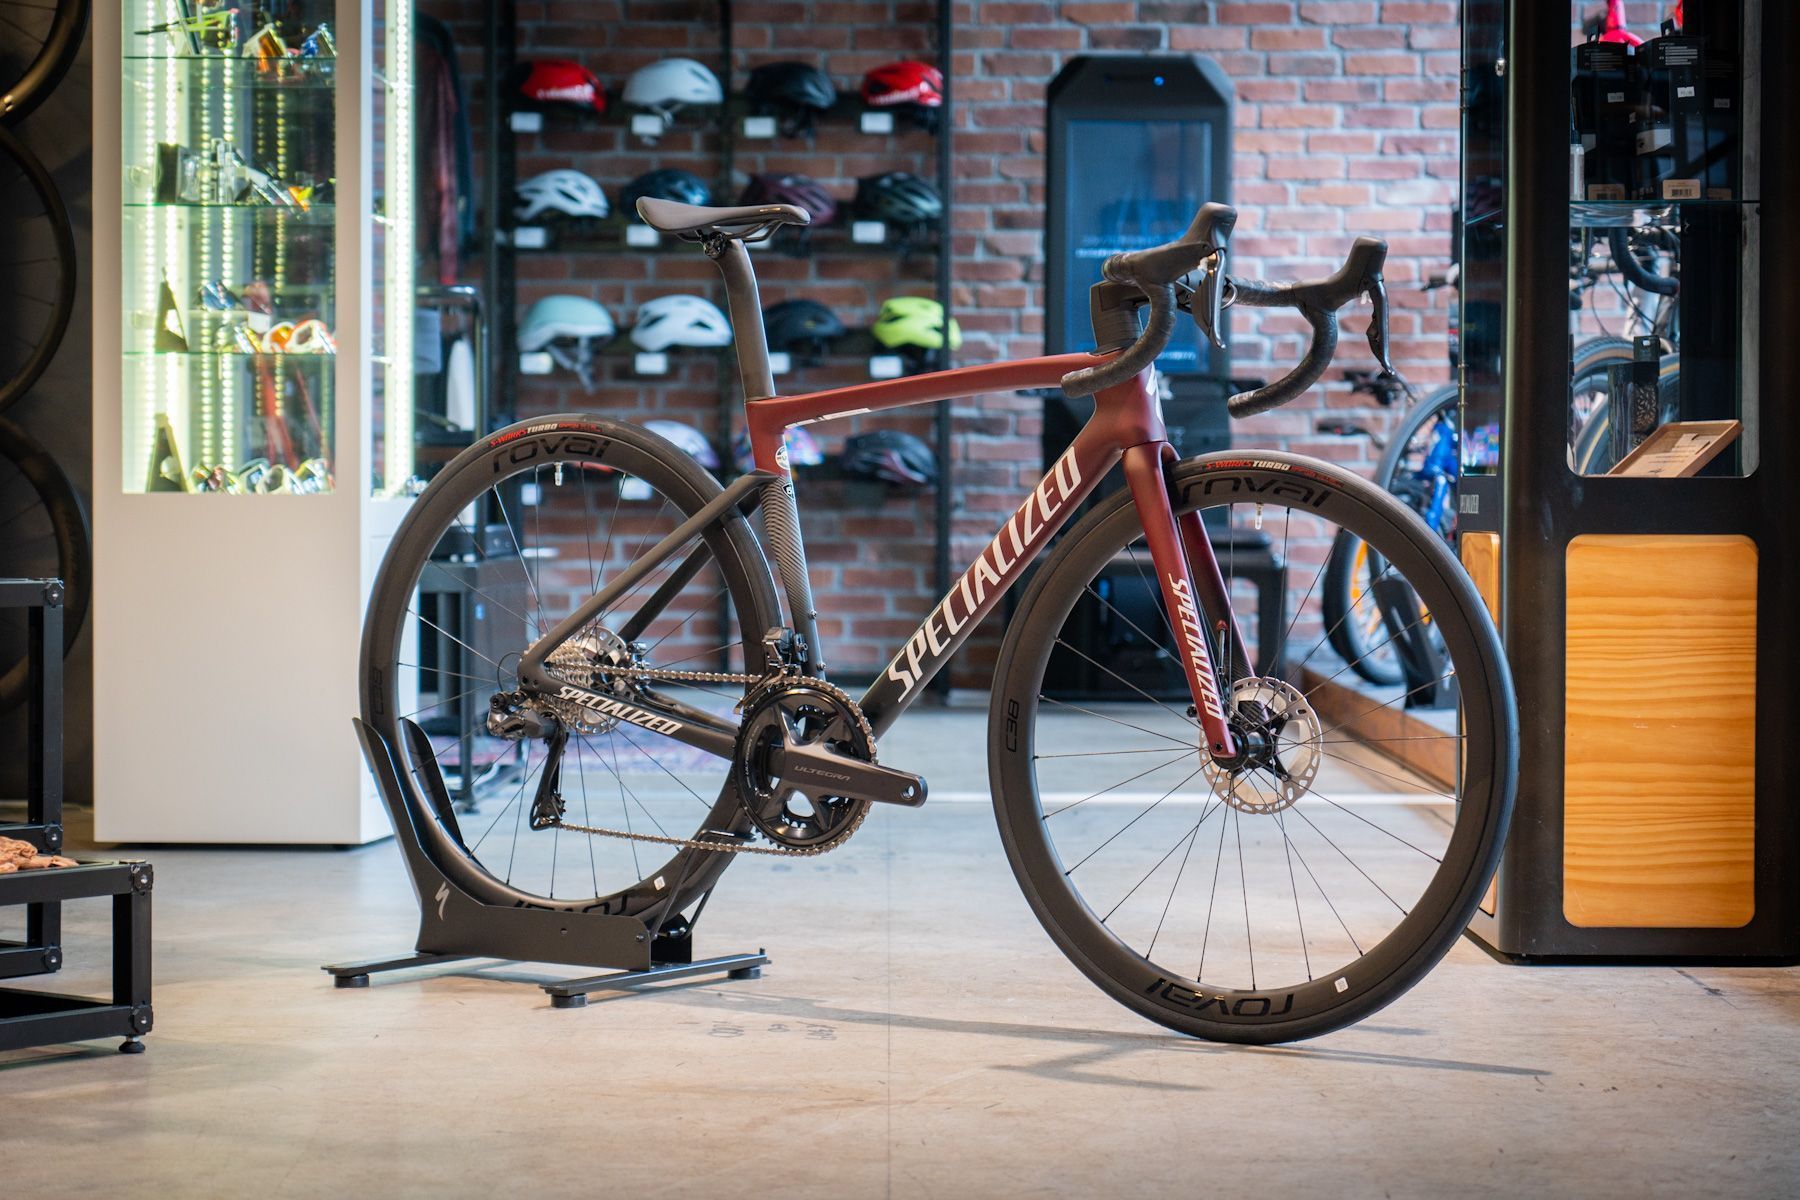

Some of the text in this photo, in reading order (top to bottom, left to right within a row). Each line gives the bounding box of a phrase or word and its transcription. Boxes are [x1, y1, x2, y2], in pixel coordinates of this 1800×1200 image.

[490, 429, 528, 448] S-WORKS
[526, 423, 558, 434] TURBO
[493, 436, 612, 474] roval
[1206, 459, 1291, 471] S-WORKS TURBO
[1182, 476, 1332, 508] roval
[888, 446, 1082, 703] SPECIALIZED
[1167, 572, 1223, 721] SPECIALIZED
[553, 686, 683, 735] SPECIALIZED
[1006, 698, 1020, 753] C38
[794, 765, 851, 781] ULTEGRA
[1144, 976, 1295, 1018] roval
